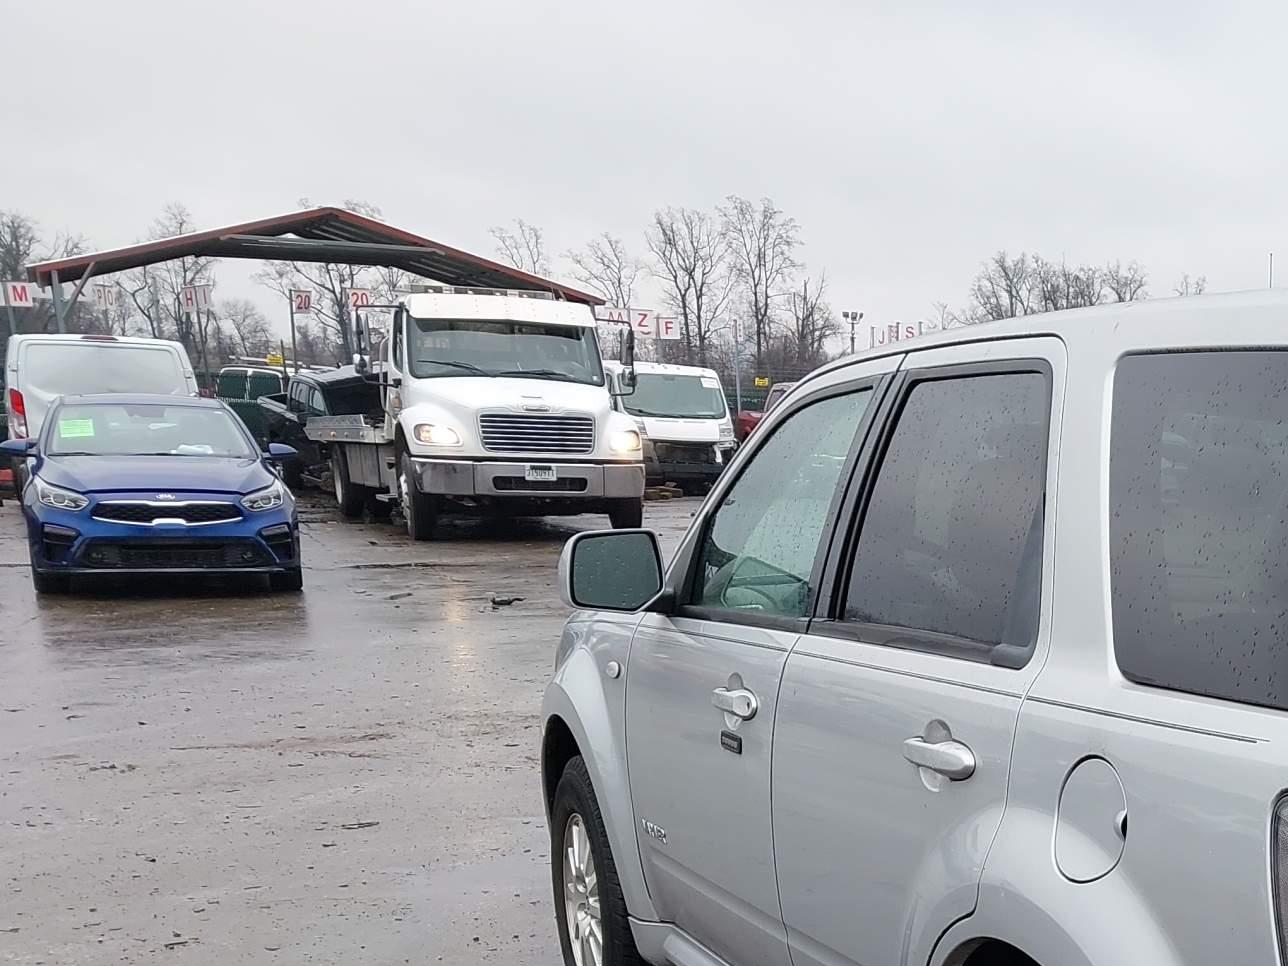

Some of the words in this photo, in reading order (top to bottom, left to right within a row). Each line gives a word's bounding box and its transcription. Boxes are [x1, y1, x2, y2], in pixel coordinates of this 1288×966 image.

[12, 285, 28, 302] M
[185, 290, 193, 307] H
[351, 292, 369, 308] 20
[295, 294, 311, 310] 20
[637, 313, 649, 328] Z
[664, 321, 674, 335] F
[905, 326, 915, 339] S
